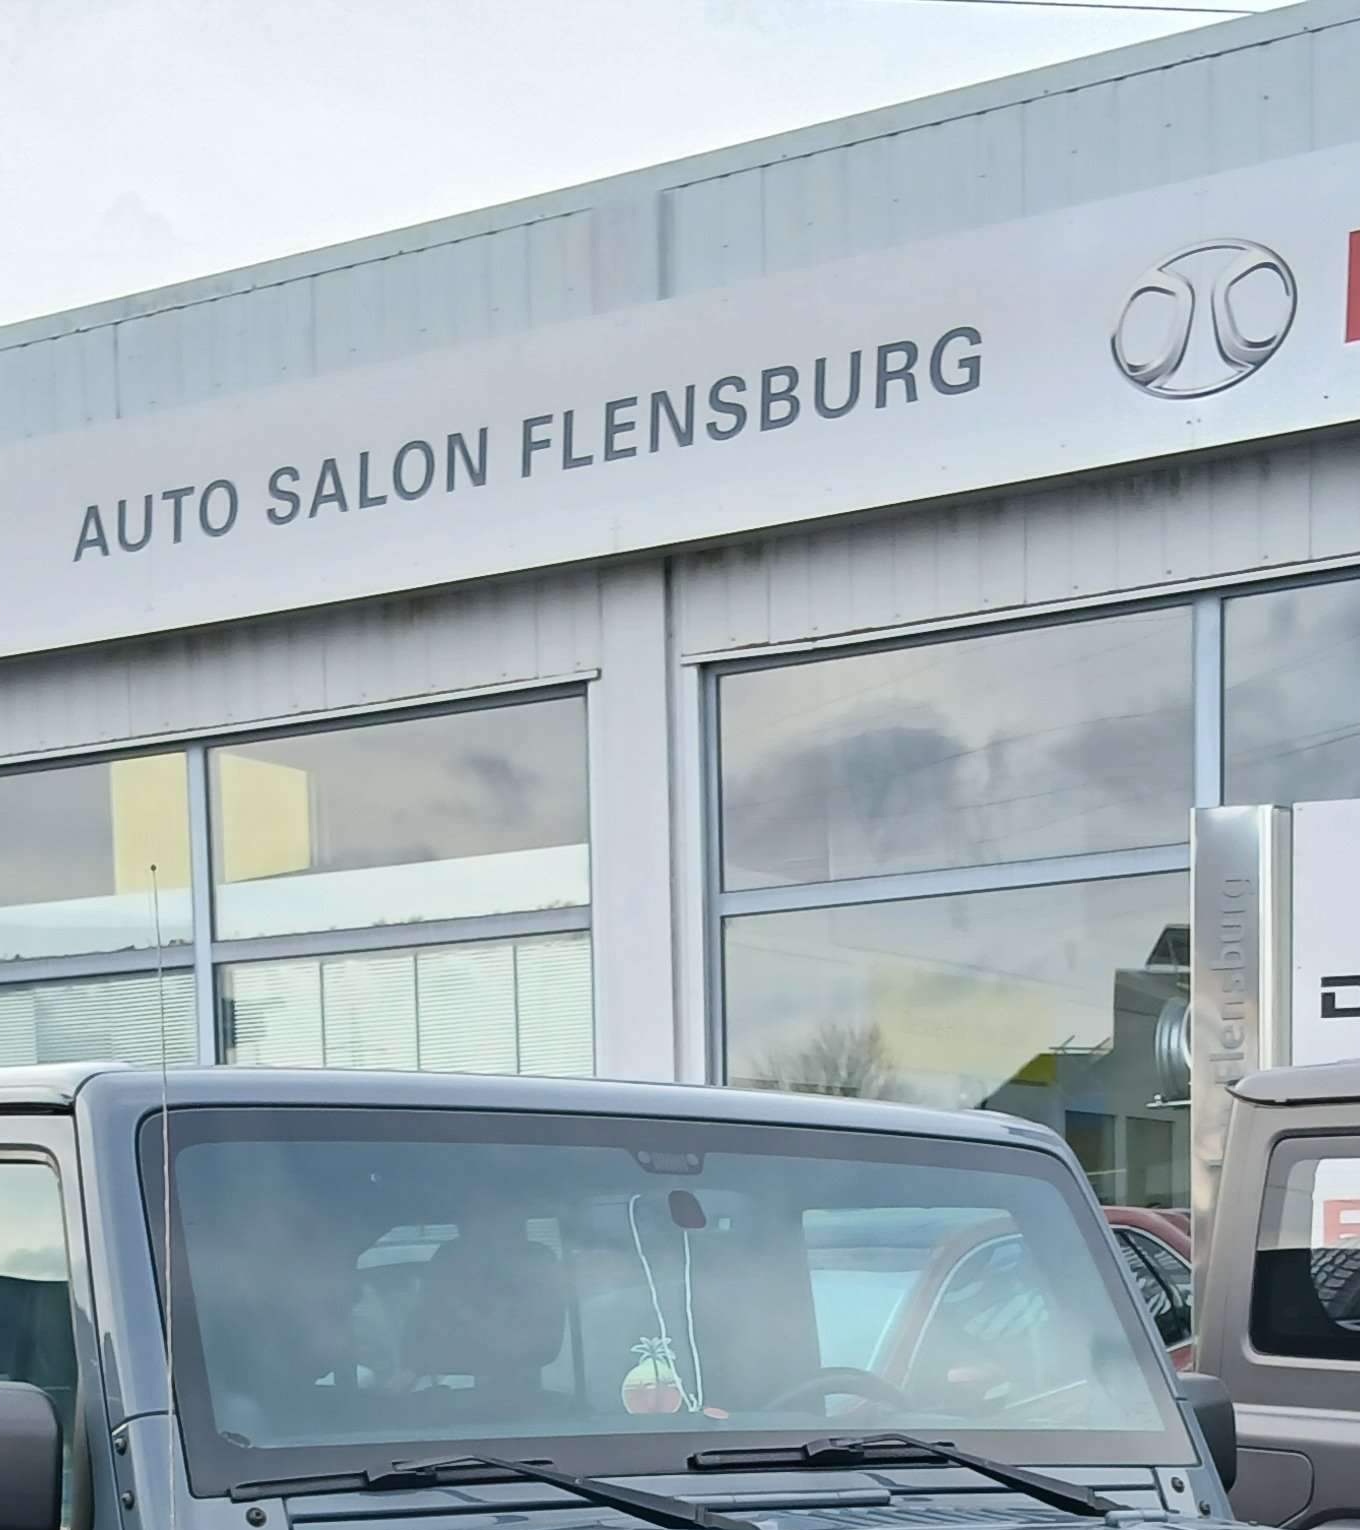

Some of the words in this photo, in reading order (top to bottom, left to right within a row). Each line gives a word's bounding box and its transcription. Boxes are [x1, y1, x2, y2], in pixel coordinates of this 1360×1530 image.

[73, 479, 239, 562] AUTO
[266, 427, 488, 526] SALON
[521, 326, 982, 478] FLENSBURG
